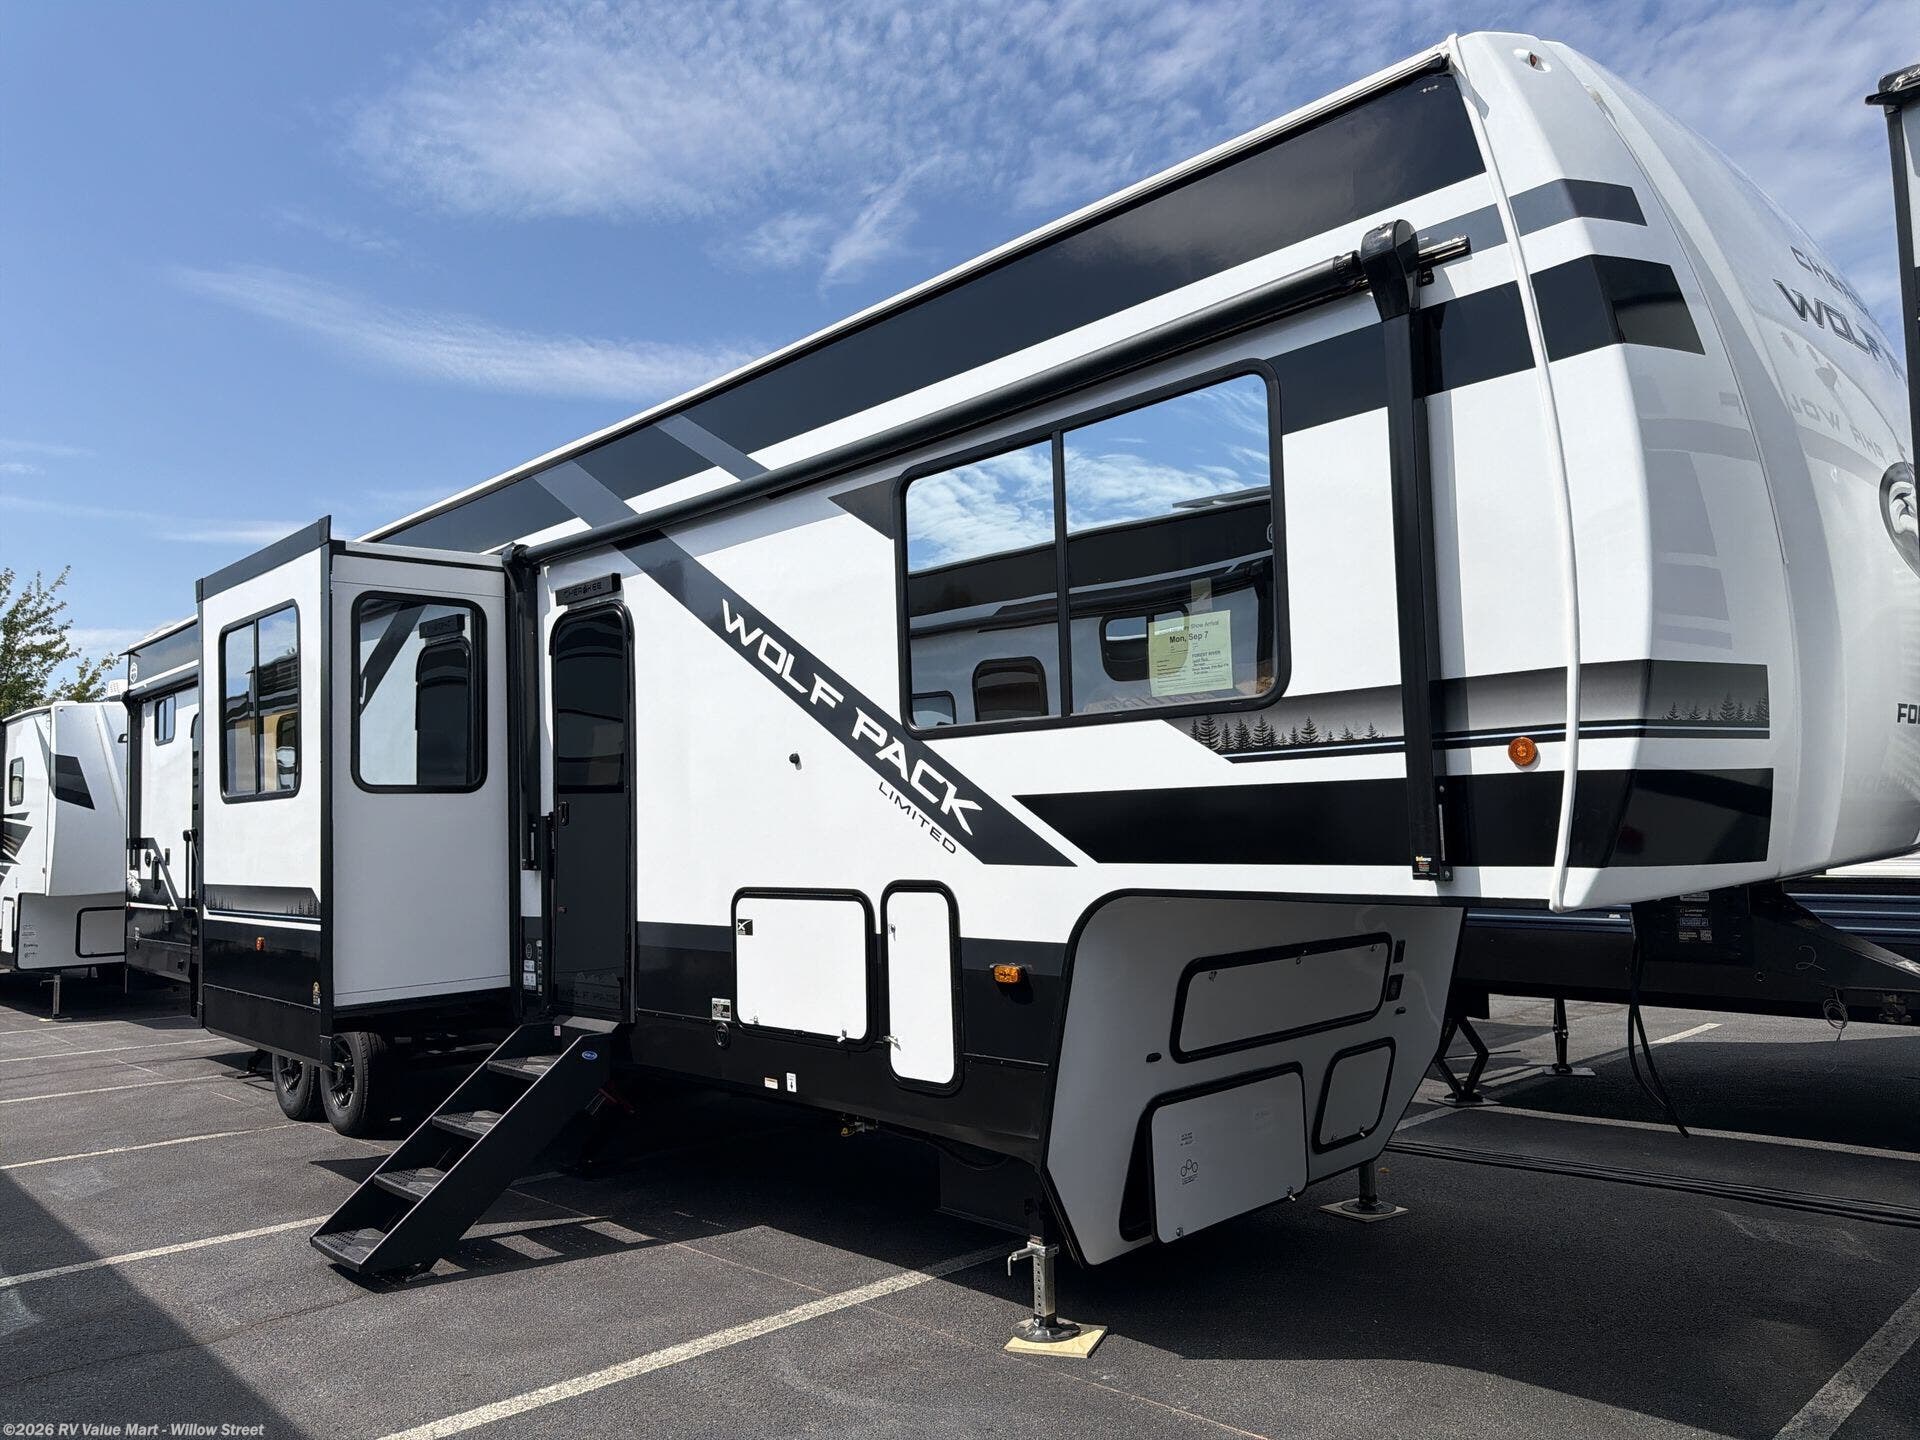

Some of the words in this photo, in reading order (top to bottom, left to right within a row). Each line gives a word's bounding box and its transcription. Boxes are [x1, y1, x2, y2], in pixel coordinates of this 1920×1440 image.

[1773, 279, 1882, 361] WOLF
[1169, 635, 1187, 643] Mon,
[1188, 633, 1203, 641] Sep
[1204, 630, 1209, 638] 7
[722, 598, 844, 709] WOLF
[851, 706, 983, 836] PACK
[1897, 703, 1920, 725] FO
[878, 781, 957, 854] LIMITED
